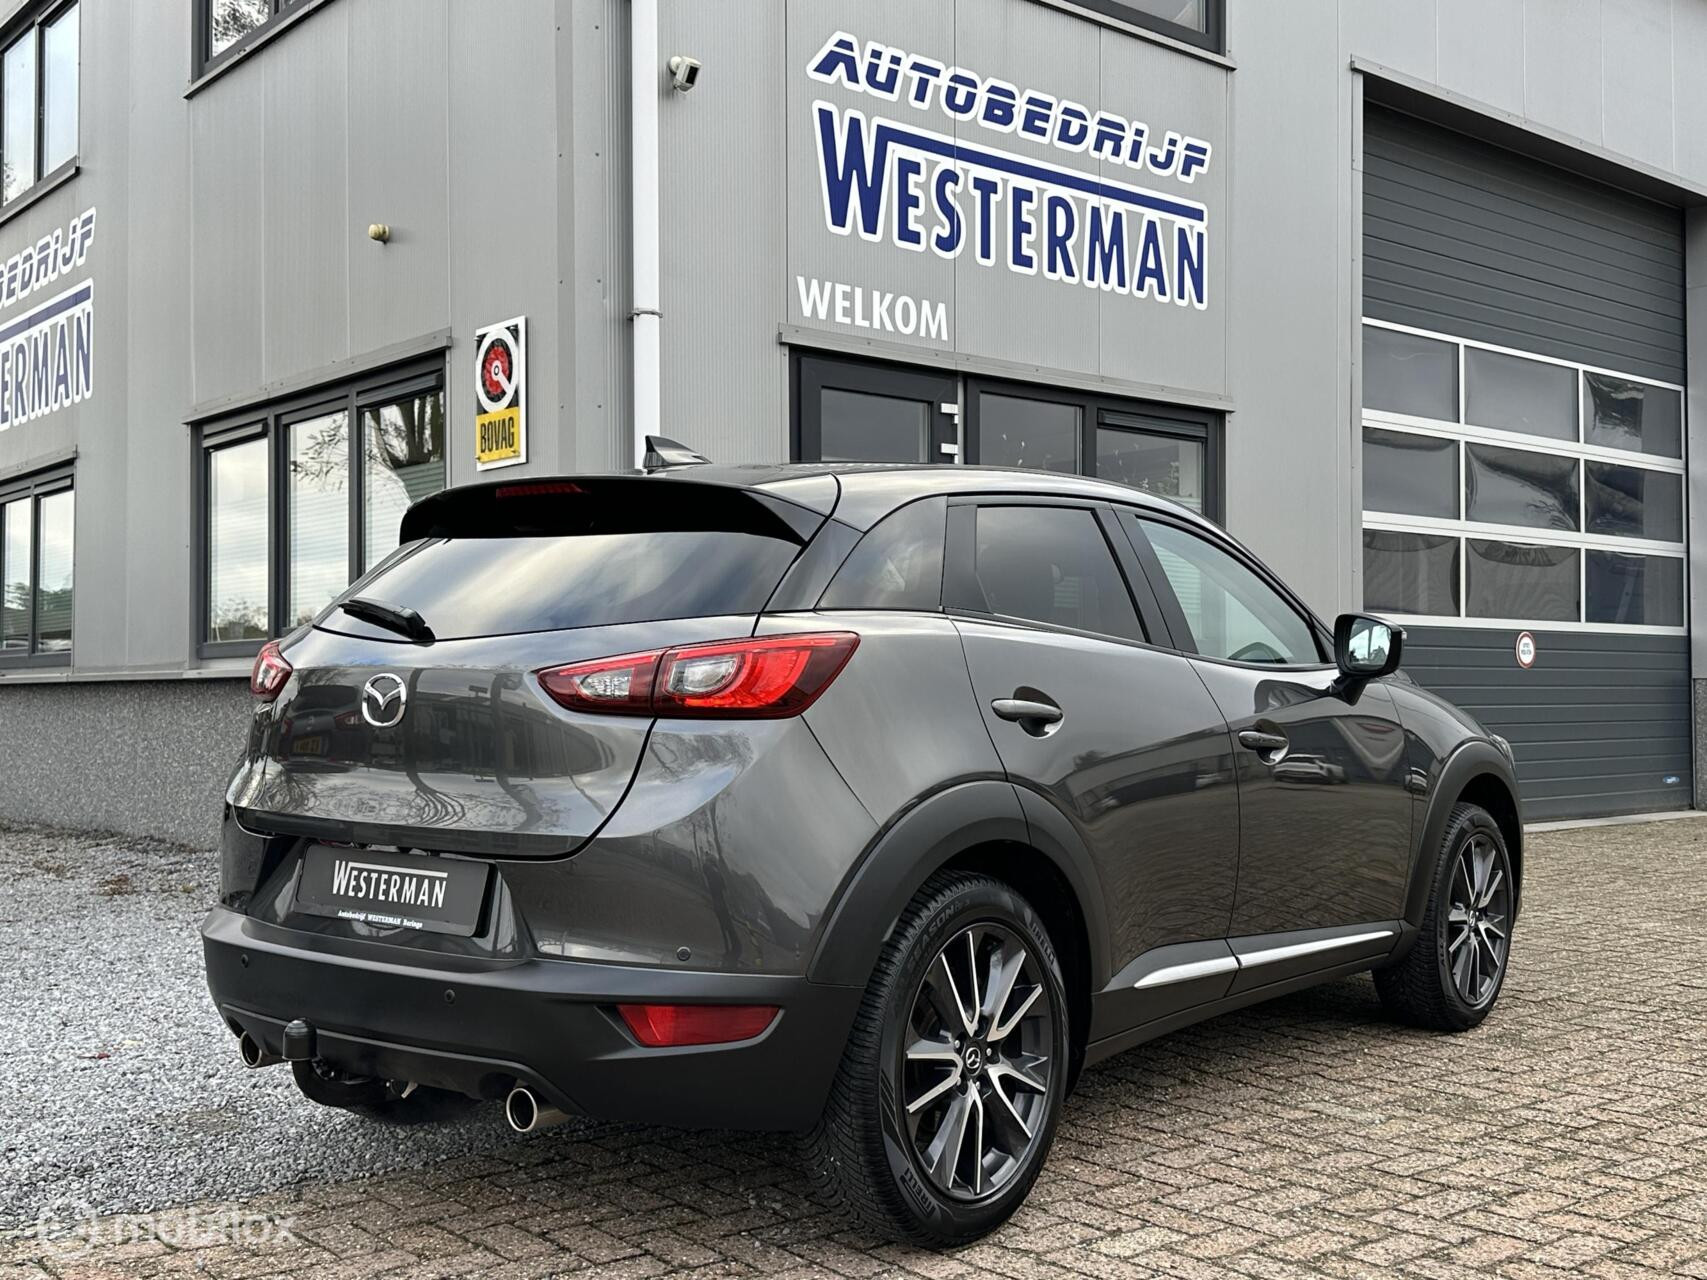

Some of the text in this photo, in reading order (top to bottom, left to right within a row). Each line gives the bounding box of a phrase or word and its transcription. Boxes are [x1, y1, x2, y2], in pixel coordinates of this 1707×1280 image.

[809, 33, 1211, 180] AUTOBEDRIJF
[813, 103, 1208, 308] WESTERMAN
[797, 274, 949, 342] WELKOM
[479, 416, 515, 454] BOVAG
[332, 859, 449, 909] WESTERMAN
[367, 913, 401, 926] WESTERMAN
[900, 1167, 937, 1218] PIRELLI
